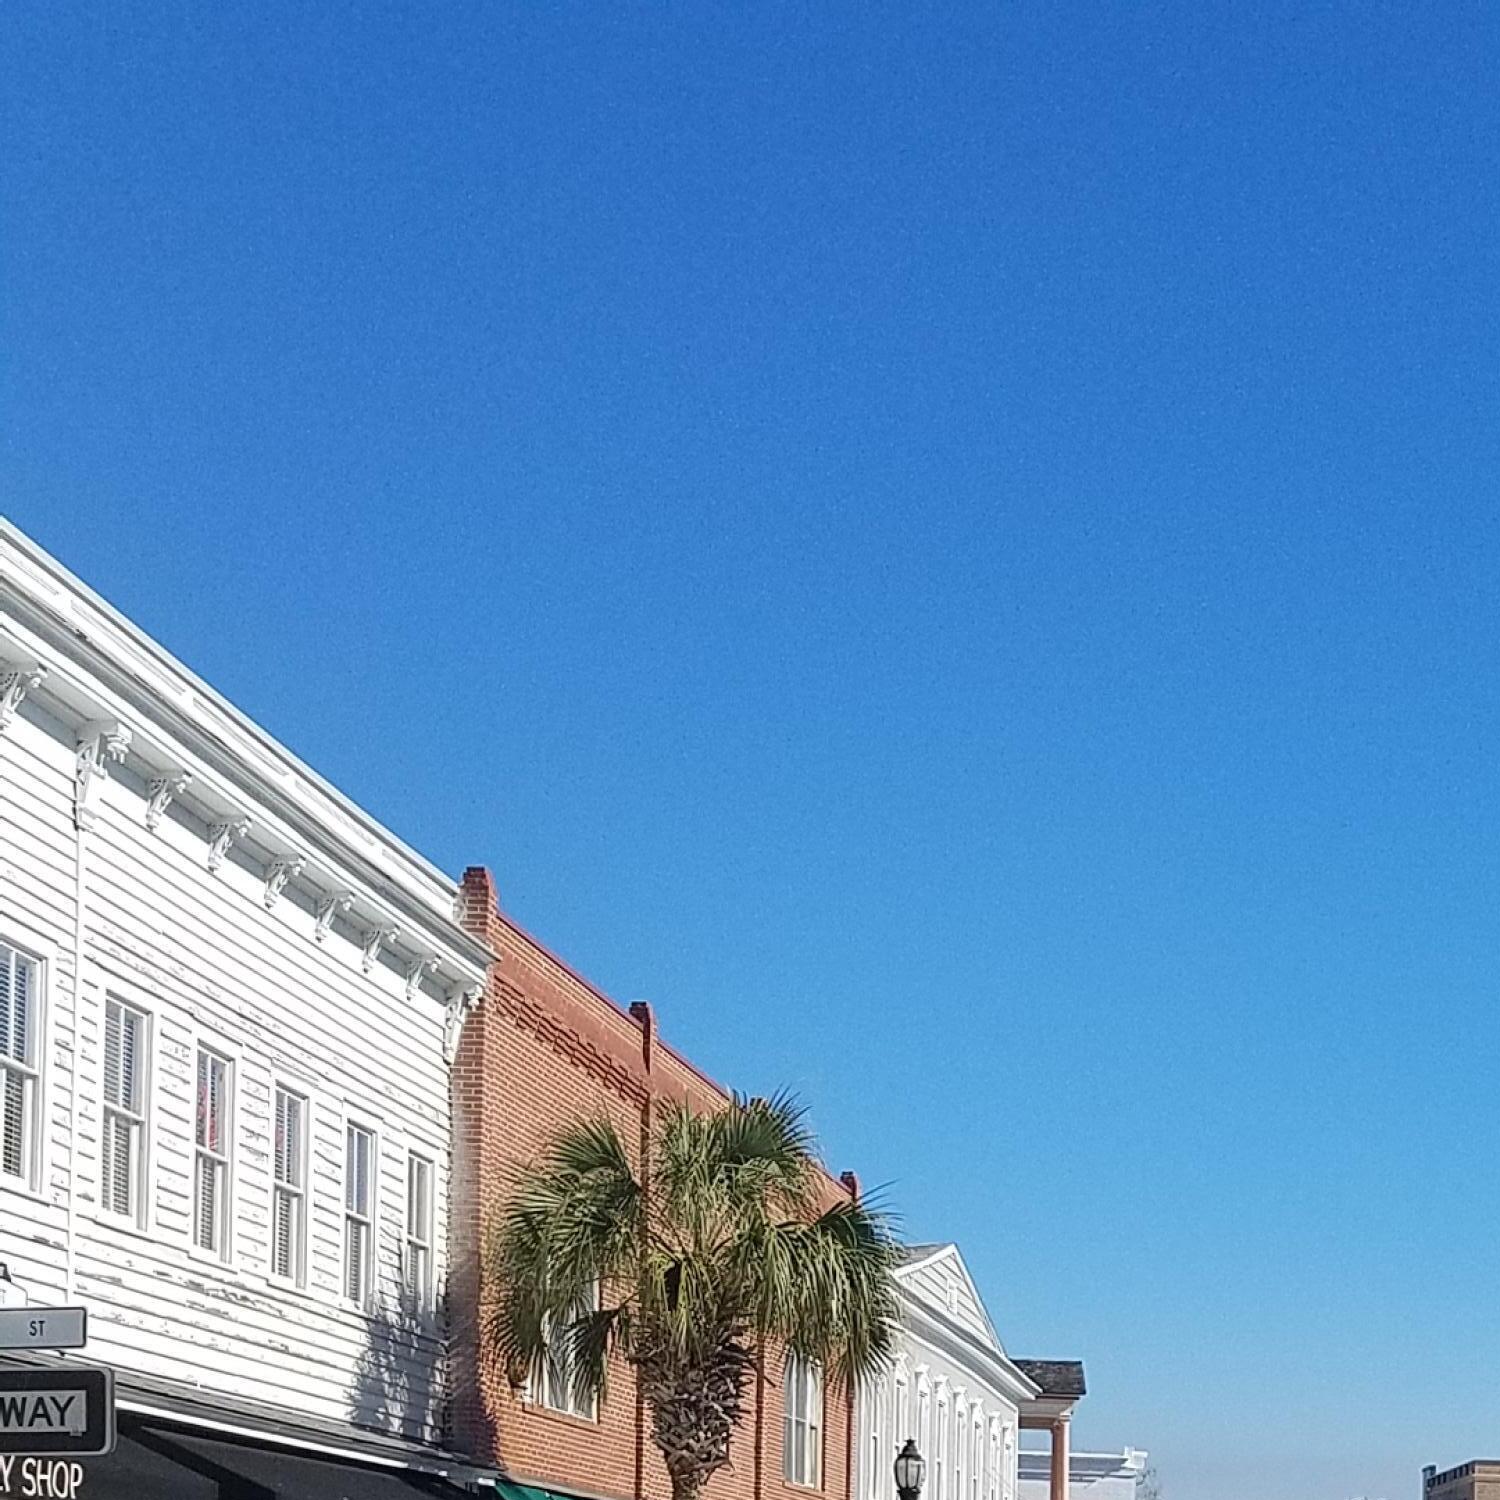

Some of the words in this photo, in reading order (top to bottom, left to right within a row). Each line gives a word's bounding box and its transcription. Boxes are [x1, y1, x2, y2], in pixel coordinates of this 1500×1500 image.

[29, 1320, 46, 1337] ST
[0, 1395, 76, 1428] WAY
[22, 1457, 83, 1500] SHOP
